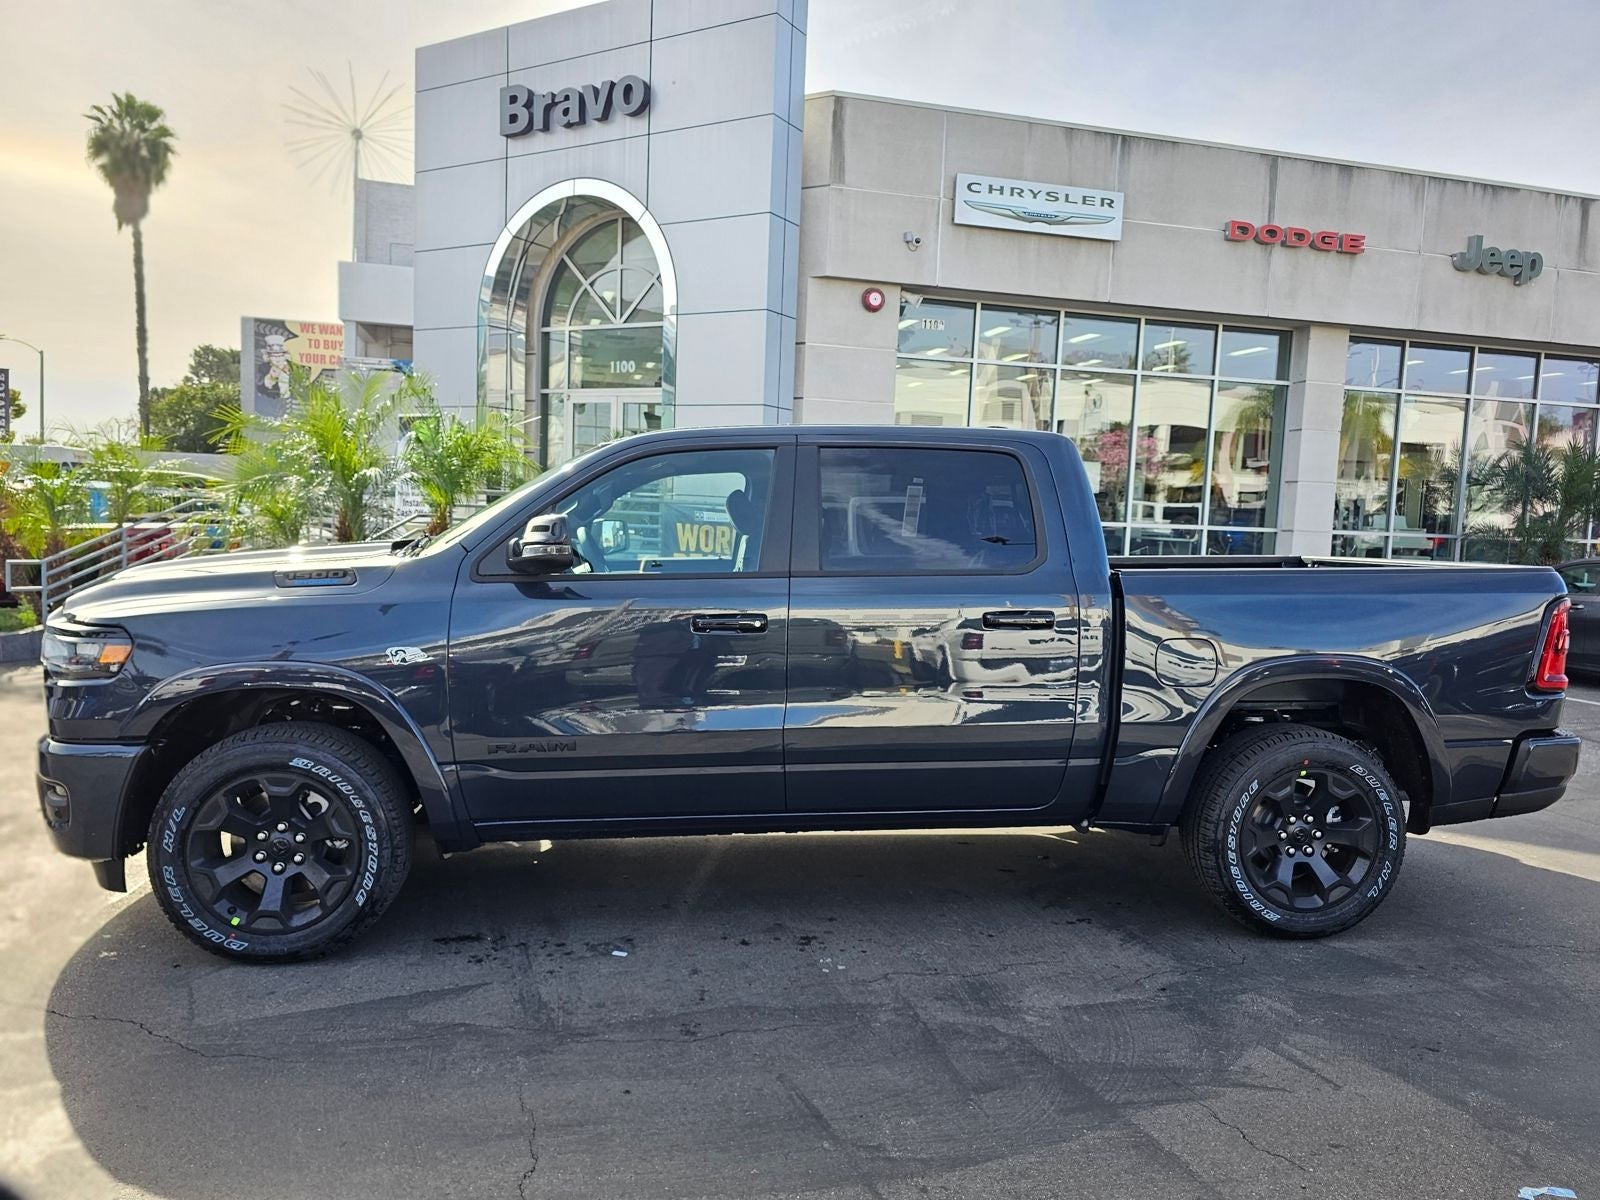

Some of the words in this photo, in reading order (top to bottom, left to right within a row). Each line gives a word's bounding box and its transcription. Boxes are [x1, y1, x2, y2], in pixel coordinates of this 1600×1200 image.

[500, 74, 650, 138] Bravo
[966, 182, 1115, 209] CHRYSLER
[1225, 219, 1366, 255] DODGE
[1454, 234, 1544, 287] Jeep
[299, 322, 316, 335] WE
[319, 323, 344, 337] WAN
[307, 338, 321, 350] TO
[323, 340, 344, 352] BUY
[298, 352, 327, 365] YOUR
[329, 355, 344, 367] CA
[610, 360, 636, 374] 1100
[287, 571, 345, 580] 1500
[488, 740, 577, 755] RAM
[1350, 764, 1398, 851] DUELER
[163, 806, 186, 853] H/L
[289, 757, 379, 908] BRIDGESTONE
[1227, 779, 1281, 922] BRIDGESTONE
[1366, 860, 1392, 899] H/L
[162, 865, 249, 951] DUELER
